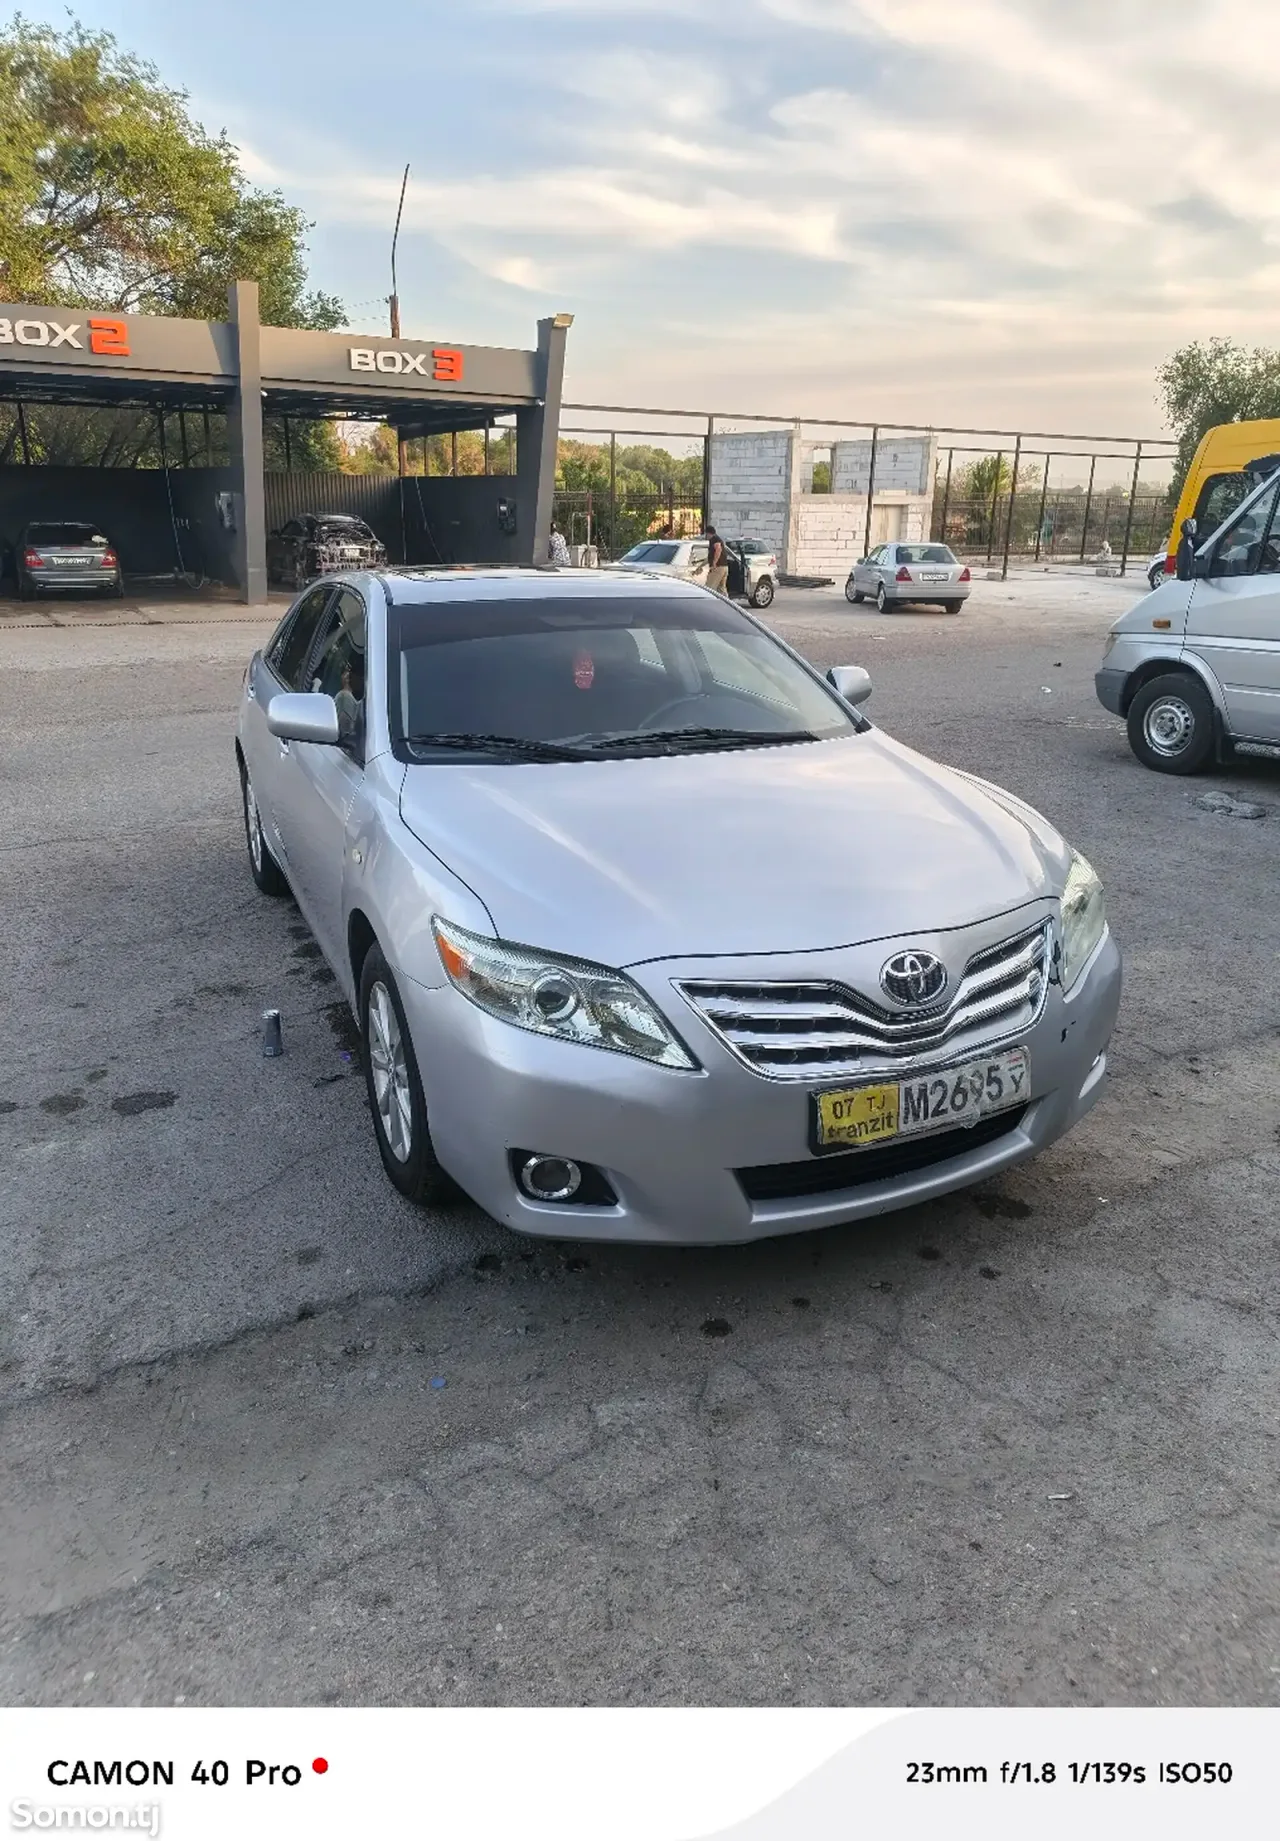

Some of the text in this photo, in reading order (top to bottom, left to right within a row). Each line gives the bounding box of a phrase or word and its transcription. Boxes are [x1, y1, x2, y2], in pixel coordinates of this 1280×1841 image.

[89, 318, 132, 357] 2
[350, 348, 463, 381] BOX 3
[832, 1094, 886, 1119] 07 TJ
[827, 1111, 894, 1138] tranzit
